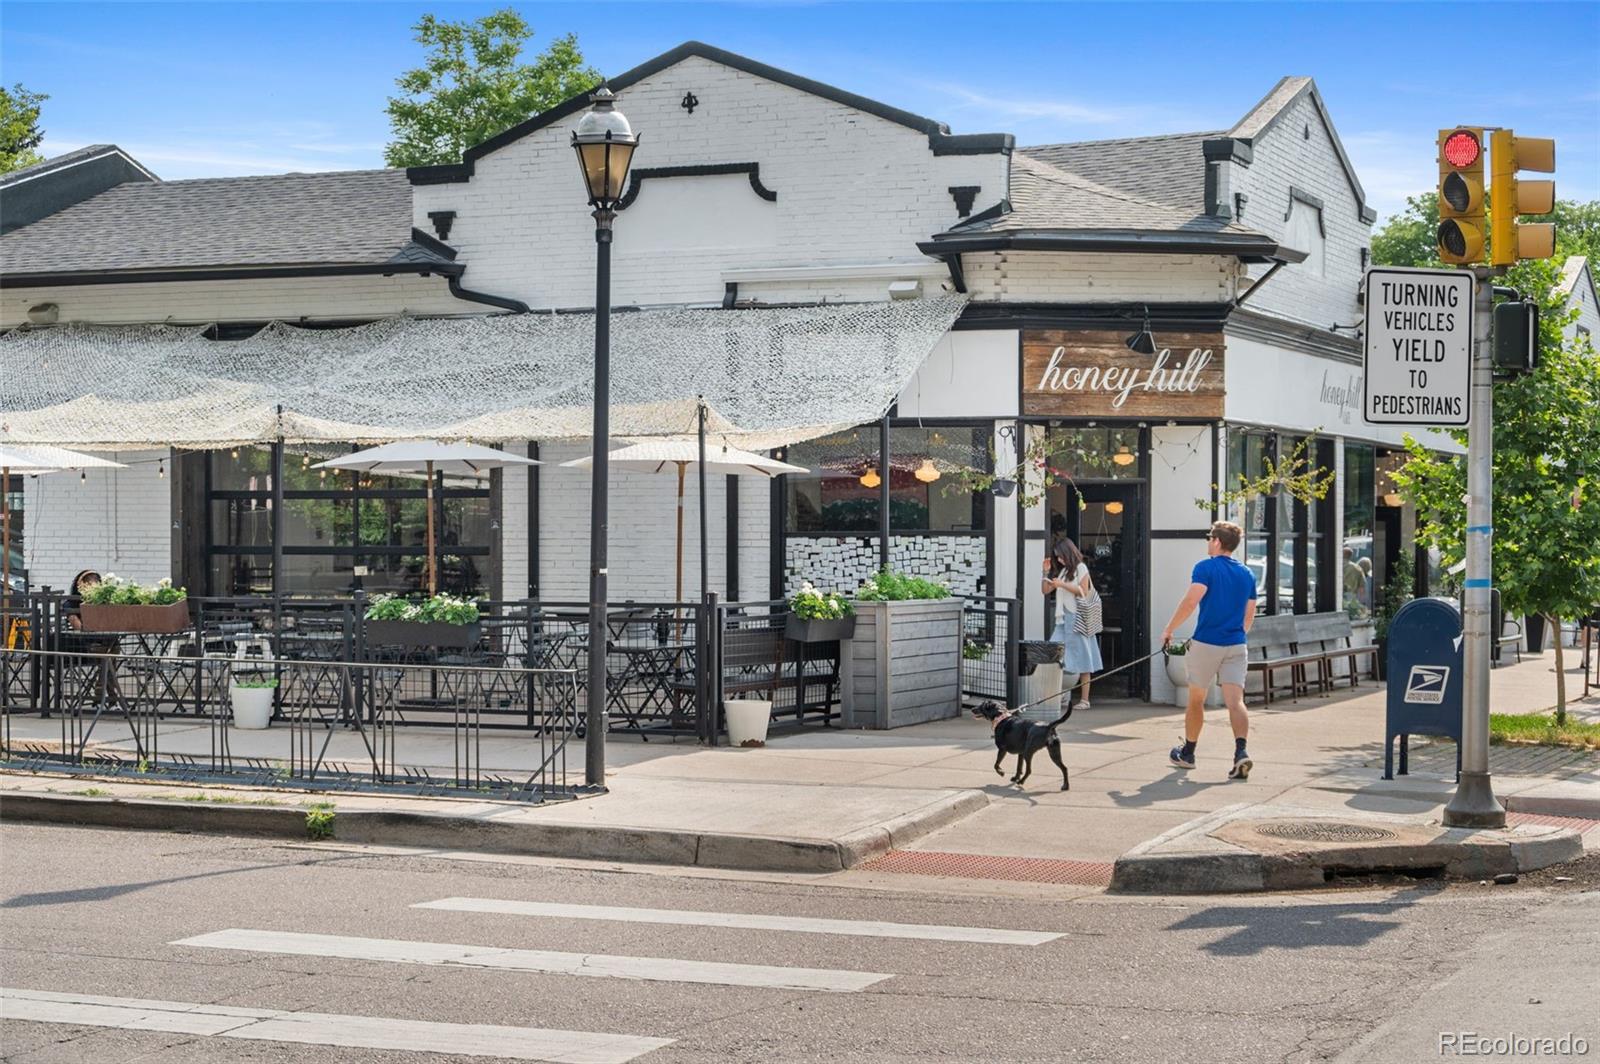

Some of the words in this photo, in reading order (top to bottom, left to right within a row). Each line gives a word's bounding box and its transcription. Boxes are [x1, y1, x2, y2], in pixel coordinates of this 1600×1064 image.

[1382, 282, 1458, 308] TURNING
[1384, 311, 1455, 332] VEHICLES
[1392, 338, 1445, 362] YIELD
[1038, 346, 1141, 408] honey
[1143, 348, 1213, 393] hill
[1409, 369, 1427, 389] TO
[1373, 395, 1461, 416] PEDESTRIANS
